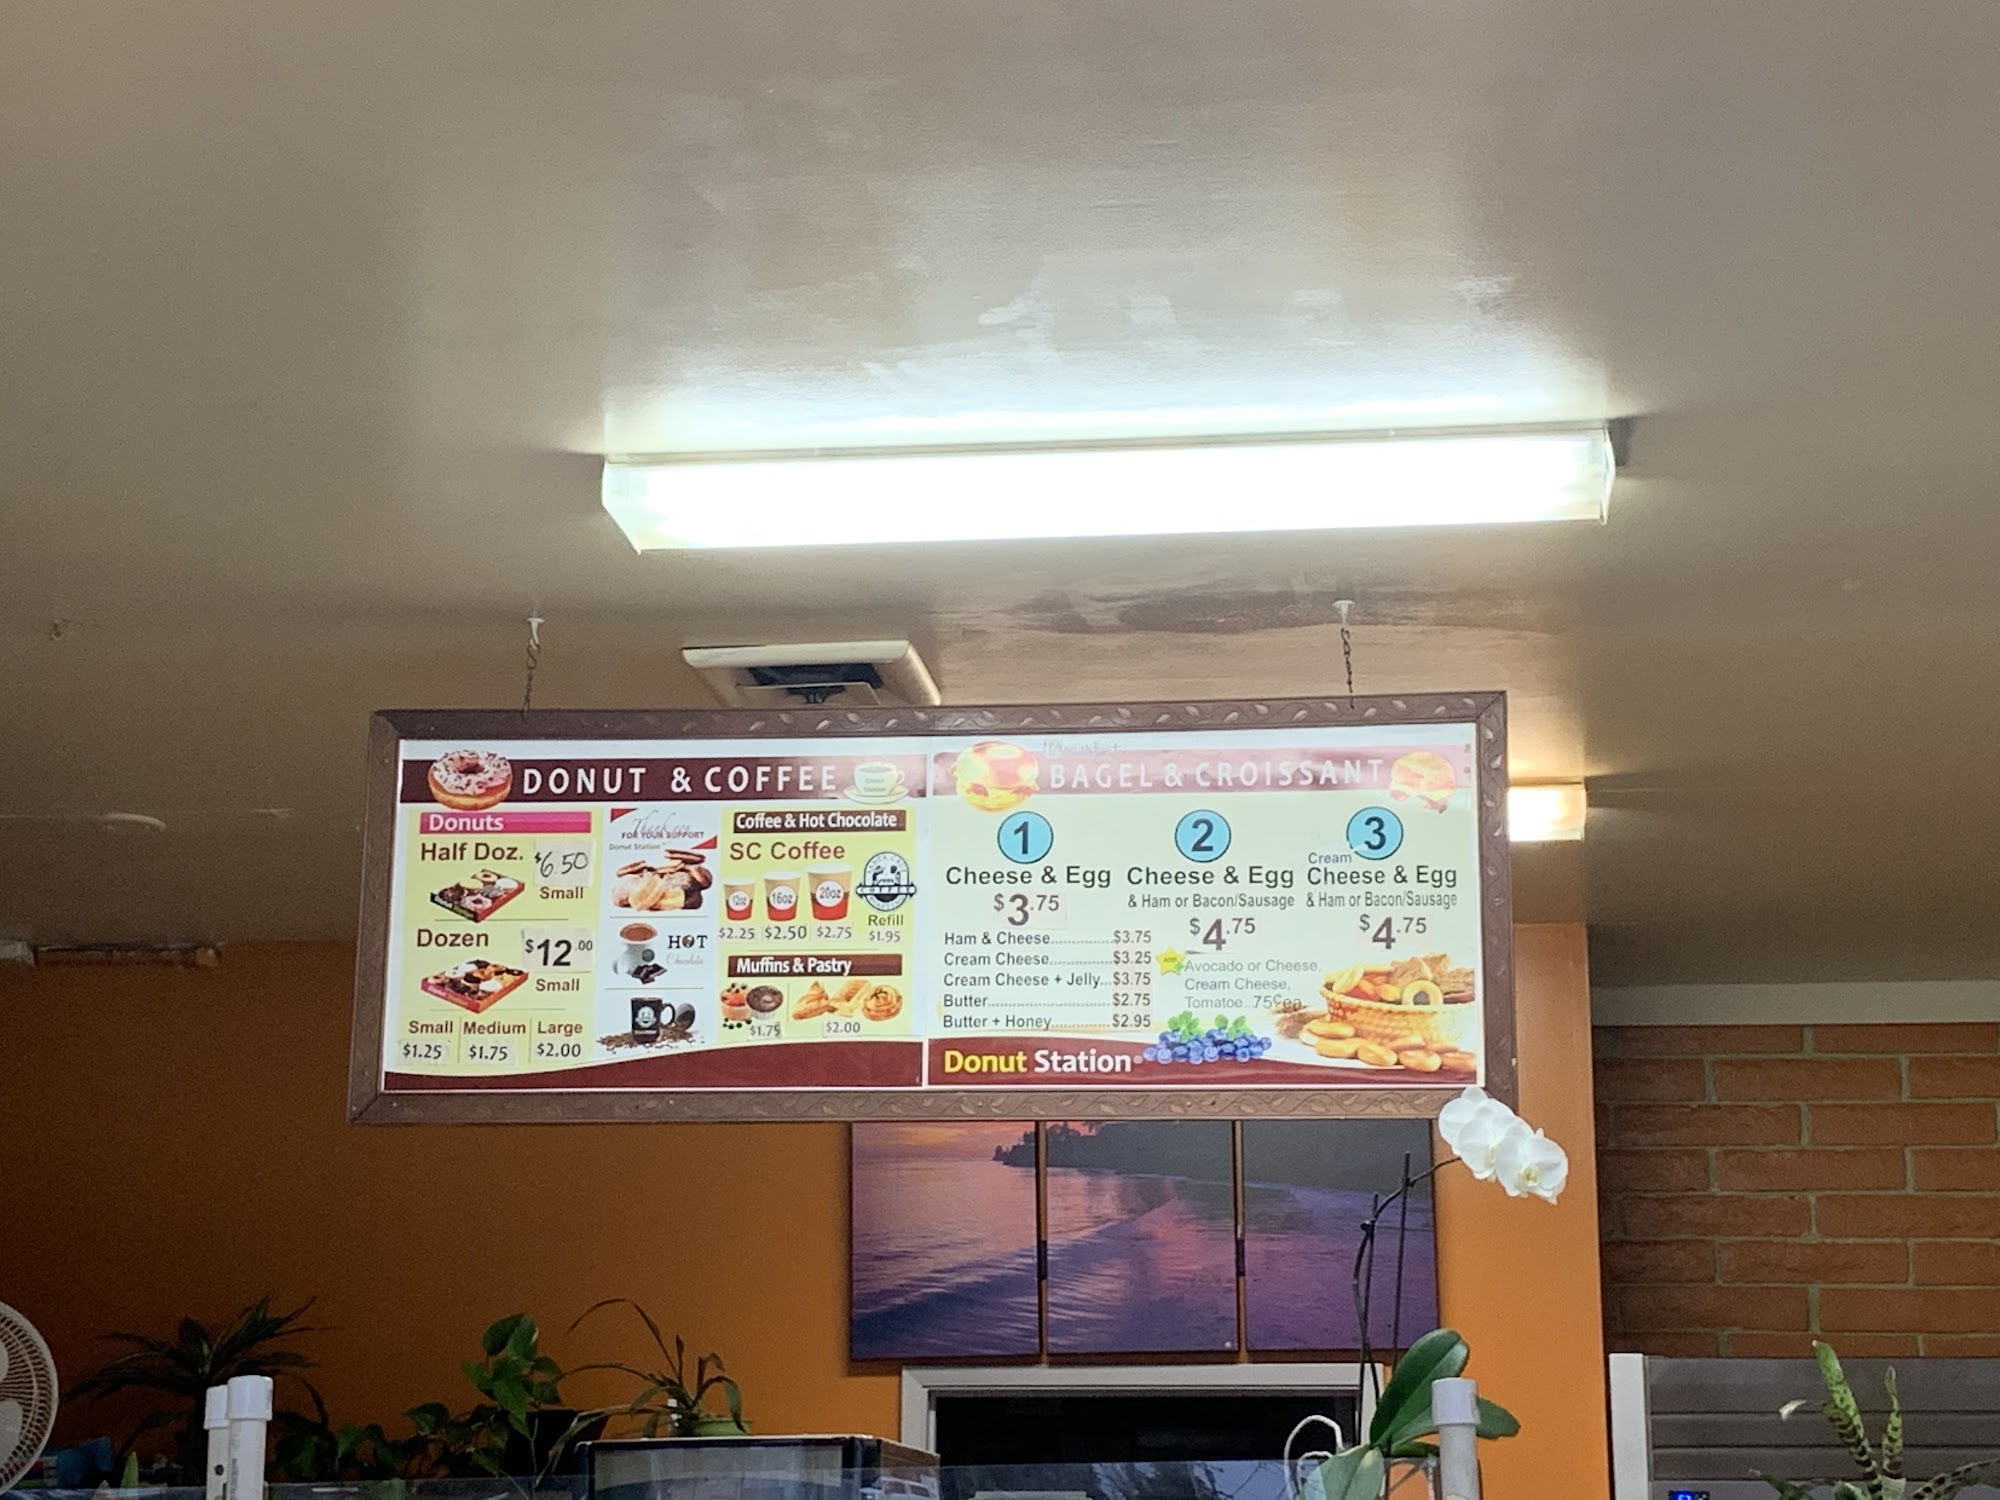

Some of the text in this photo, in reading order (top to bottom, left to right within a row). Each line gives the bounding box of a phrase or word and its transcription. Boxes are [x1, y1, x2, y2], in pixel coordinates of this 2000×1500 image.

[523, 767, 646, 795] DONUT
[671, 767, 691, 793] &
[704, 766, 836, 793] COFFEE
[1050, 759, 1383, 789] BAGEL & CROISSANT
[428, 814, 504, 832] Donuts
[736, 811, 898, 830] Coffee & Hot Chocolate
[641, 831, 663, 839] YOUR
[666, 831, 705, 839] SUPPORT
[1013, 821, 1028, 854] 1
[1191, 819, 1214, 852] 2
[1364, 816, 1387, 850] 3
[420, 843, 524, 861] Half Doz.
[729, 841, 846, 860] SC Coffee
[1308, 852, 1352, 865] Cream
[946, 866, 1111, 888] Cheese & Egg
[1127, 866, 1294, 888] Cheese & Egg
[1307, 865, 1457, 888] Cheese & Egg
[540, 887, 584, 900] Small
[771, 892, 793, 904] 16oz
[819, 887, 841, 899] 20oz
[1306, 891, 1458, 908] & Ham or Bacon/Sausage
[993, 893, 1060, 926] $3.75
[1128, 893, 1295, 910] & Ham or Bacon/Sausage
[868, 914, 904, 927] Refill
[417, 930, 489, 948] Dozen
[719, 927, 755, 940] $2.25
[764, 926, 807, 940] $2.50
[816, 926, 852, 940] $2.75
[868, 929, 900, 943] $1.95
[944, 930, 1152, 945] Ham & Cheese $3.75
[1190, 918, 1256, 951] $4.75
[1359, 914, 1427, 949] $4.75
[525, 939, 593, 967] $12.00
[944, 951, 1152, 966] Cream Cheese $3.25
[737, 958, 852, 976] Muffins & Pastry
[1185, 960, 1244, 972] Avocado
[1247, 962, 1261, 972] or
[535, 979, 580, 992] Small
[943, 972, 1151, 990] Cream Cheese + Jelly $3.75
[1185, 977, 1291, 991] Cream Cheese,
[943, 993, 1151, 1008] Butter $2.75
[409, 1020, 453, 1034] Small
[463, 1021, 527, 1035] Medium
[537, 1021, 583, 1037] Large
[750, 1024, 780, 1037] $1.75
[825, 1020, 861, 1034] $2.00
[943, 1014, 1151, 1031] Butter + Honey $2.95
[403, 1044, 442, 1059] $1.25
[469, 1045, 508, 1061] $1.75
[537, 1043, 581, 1058] $2.00
[944, 1048, 1132, 1074] Donut Station
